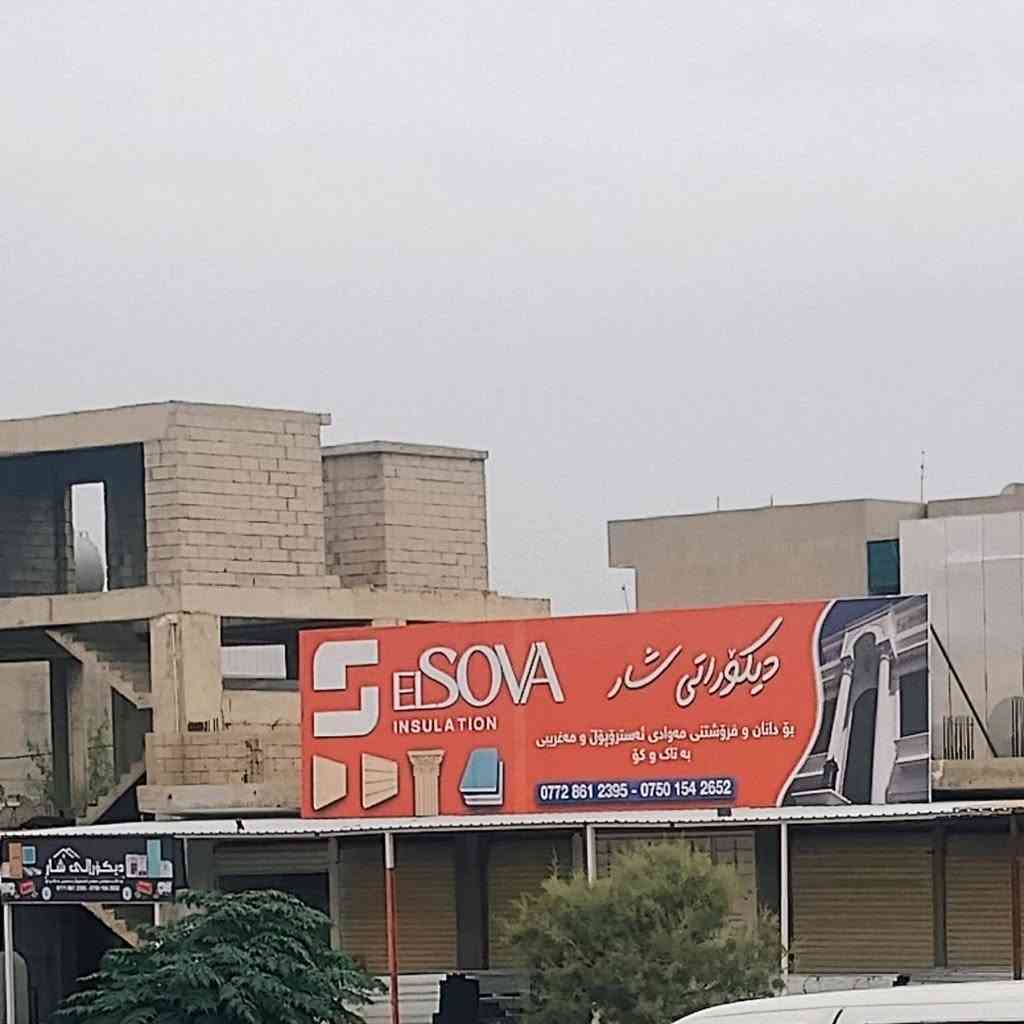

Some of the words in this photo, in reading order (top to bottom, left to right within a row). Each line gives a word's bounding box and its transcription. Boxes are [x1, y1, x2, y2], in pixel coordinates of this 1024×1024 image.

[607, 645, 683, 699] شار
[393, 716, 497, 734] INSULATION
[752, 720, 778, 736] دانان
[782, 722, 795, 738] بۆ
[578, 733, 587, 746] و
[742, 727, 749, 740] و
[648, 751, 657, 764] و
[540, 783, 569, 800] 0772
[571, 782, 593, 800] 861
[597, 782, 629, 799] 2395
[640, 781, 671, 798] 0750
[674, 780, 696, 796] 154
[699, 779, 732, 796] 2652
